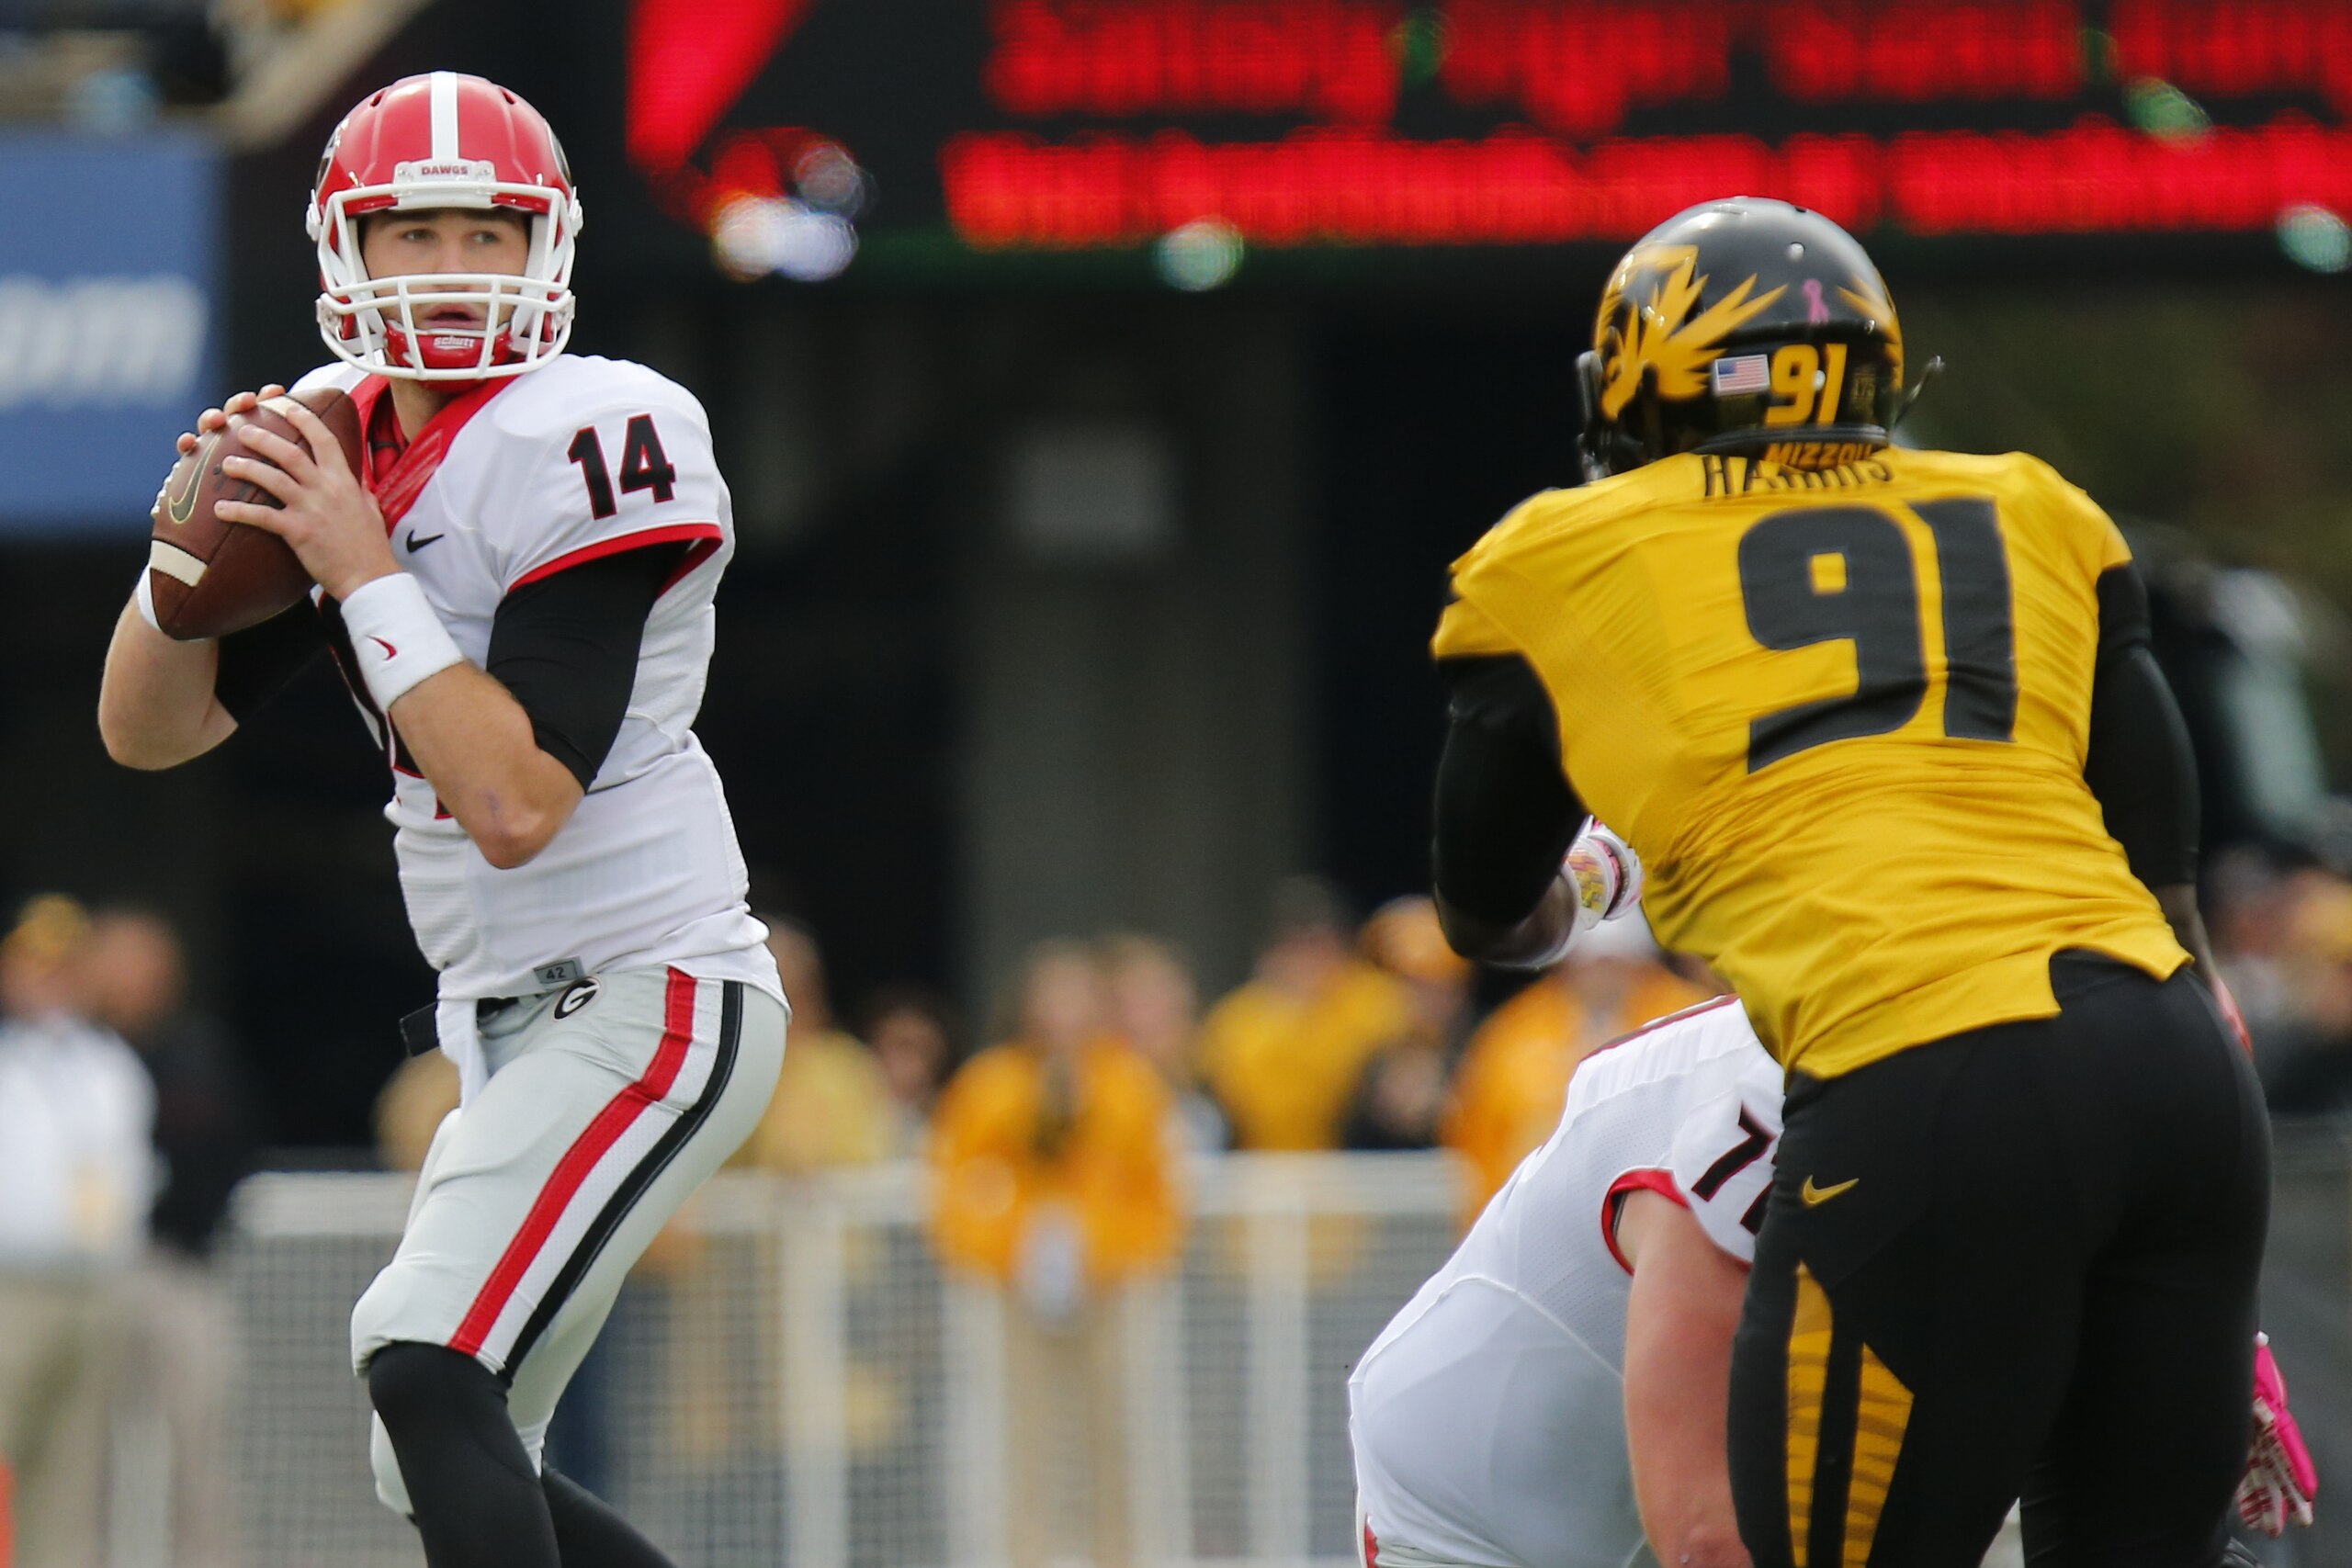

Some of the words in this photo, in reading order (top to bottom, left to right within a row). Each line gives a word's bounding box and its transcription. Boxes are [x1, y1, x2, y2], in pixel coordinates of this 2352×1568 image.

[422, 165, 468, 175] DAWGS
[1765, 344, 1848, 427] 91
[567, 413, 676, 522] 14
[1738, 495, 2018, 774] 91
[546, 966, 566, 980] 42
